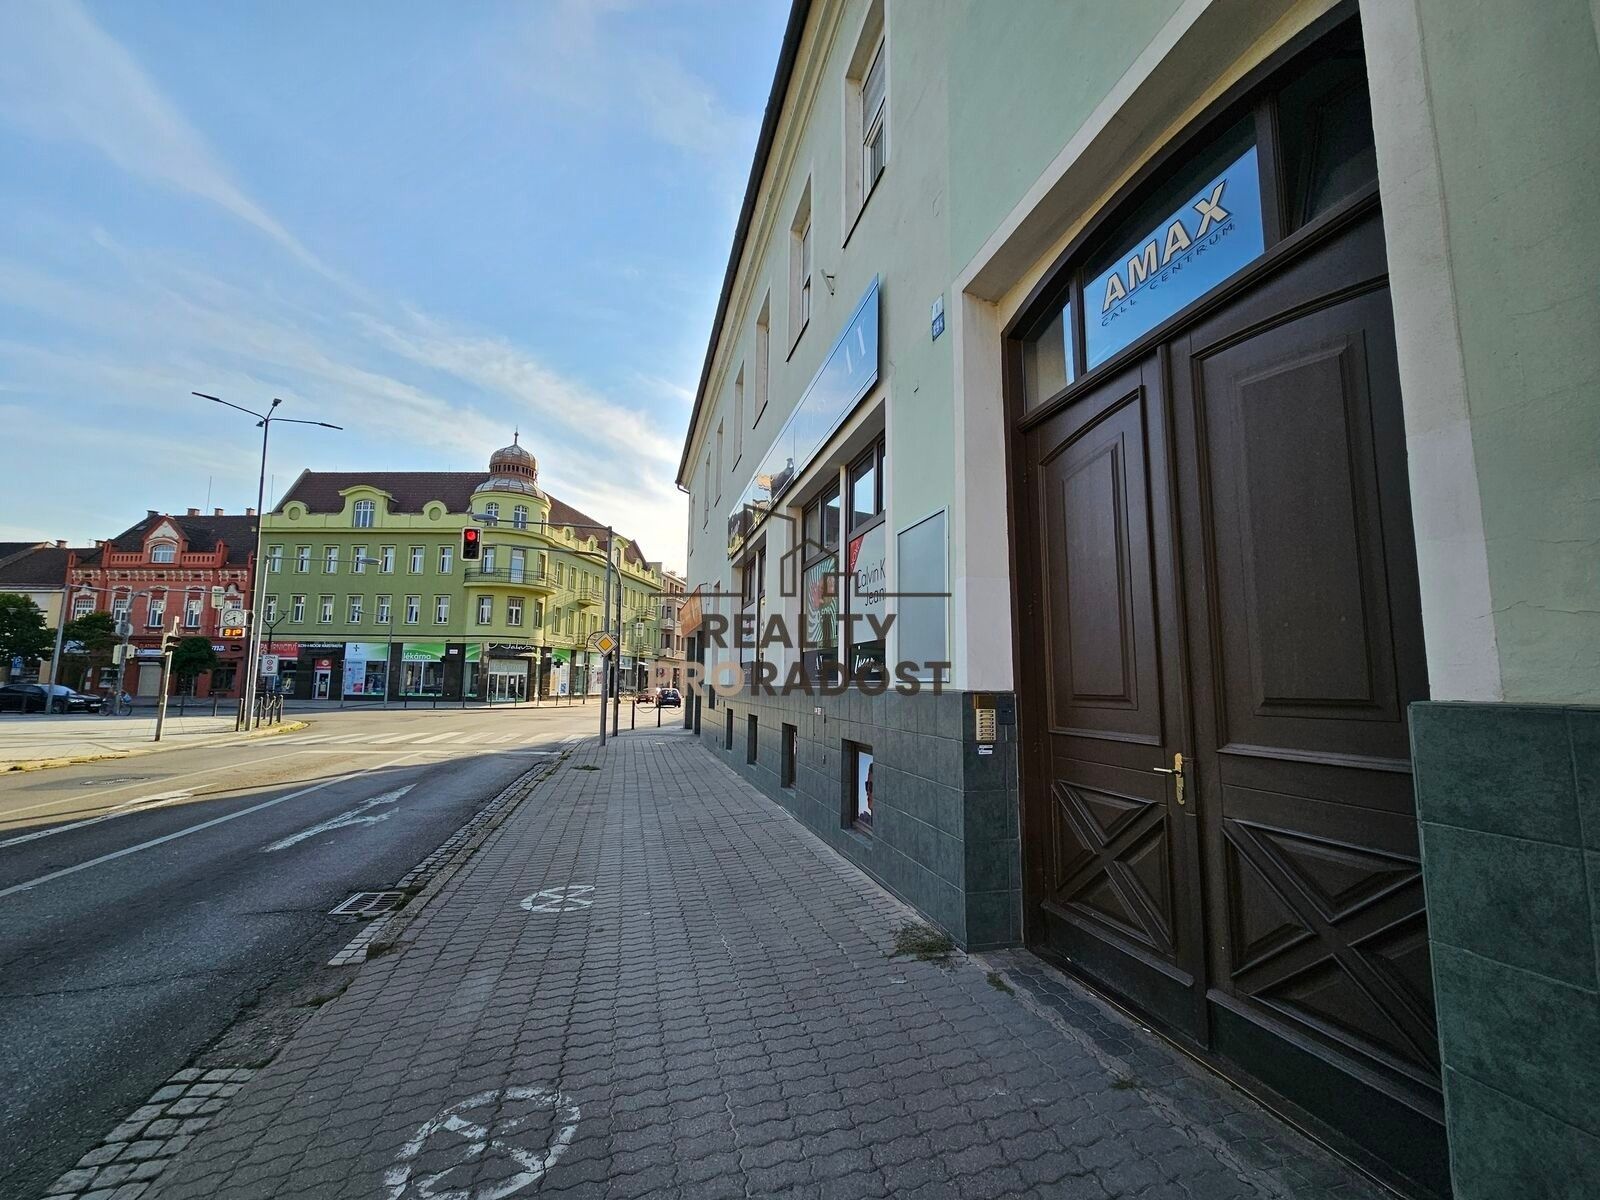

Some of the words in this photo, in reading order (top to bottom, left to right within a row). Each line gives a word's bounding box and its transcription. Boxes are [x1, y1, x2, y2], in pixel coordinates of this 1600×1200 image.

[1101, 178, 1231, 314] AMAX
[1101, 299, 1137, 327] CALL
[1149, 222, 1235, 290] CENTRUM
[856, 565, 879, 588] Calvin
[865, 586, 886, 606] Jean
[260, 641, 297, 651] PAÍRNICTVÍ
[403, 652, 431, 660] lékárna
